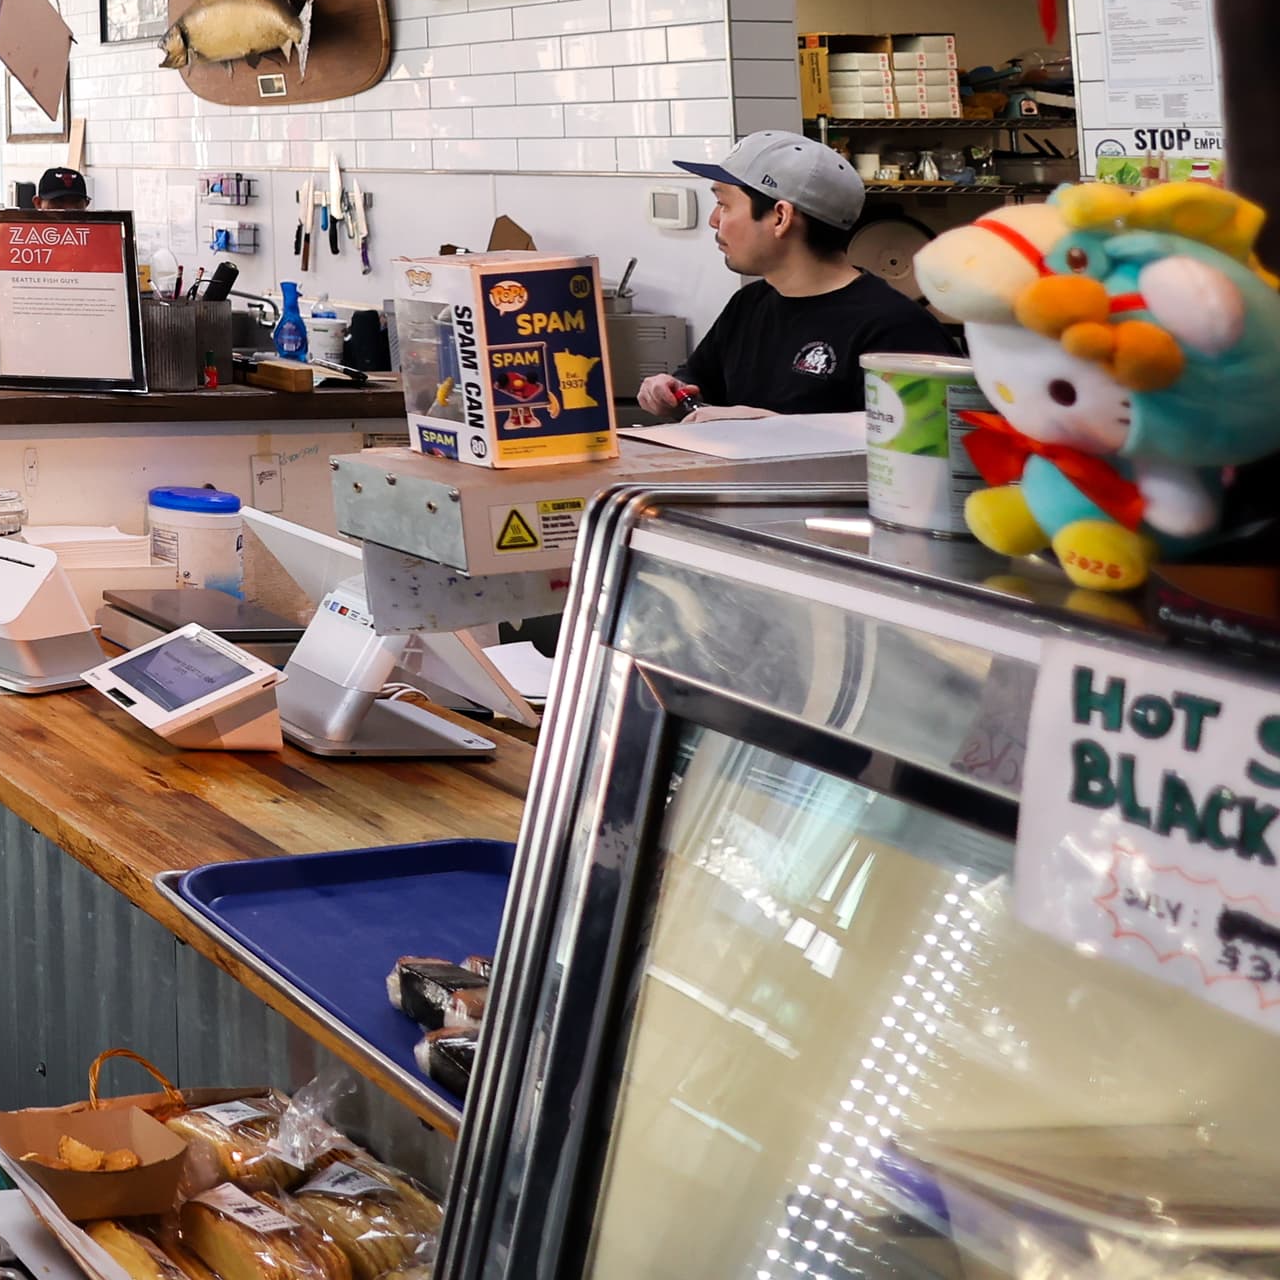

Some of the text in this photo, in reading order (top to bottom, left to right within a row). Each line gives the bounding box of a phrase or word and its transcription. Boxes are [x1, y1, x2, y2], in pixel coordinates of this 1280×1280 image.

[1134, 128, 1192, 152] STOP
[9, 227, 90, 247] ZAGAT
[10, 248, 52, 265] 2017
[11, 277, 41, 285] SEATTLE
[43, 277, 59, 285] FISH
[571, 278, 588, 294] 80
[516, 309, 586, 336] SPAM
[454, 304, 485, 430] SPAM CAN
[491, 349, 540, 368] SPAM
[560, 378, 585, 391] 1937
[422, 431, 456, 447] SPAM
[471, 439, 485, 455] 80
[1071, 664, 1223, 753] HOT
[1069, 737, 1280, 867] BLACK
